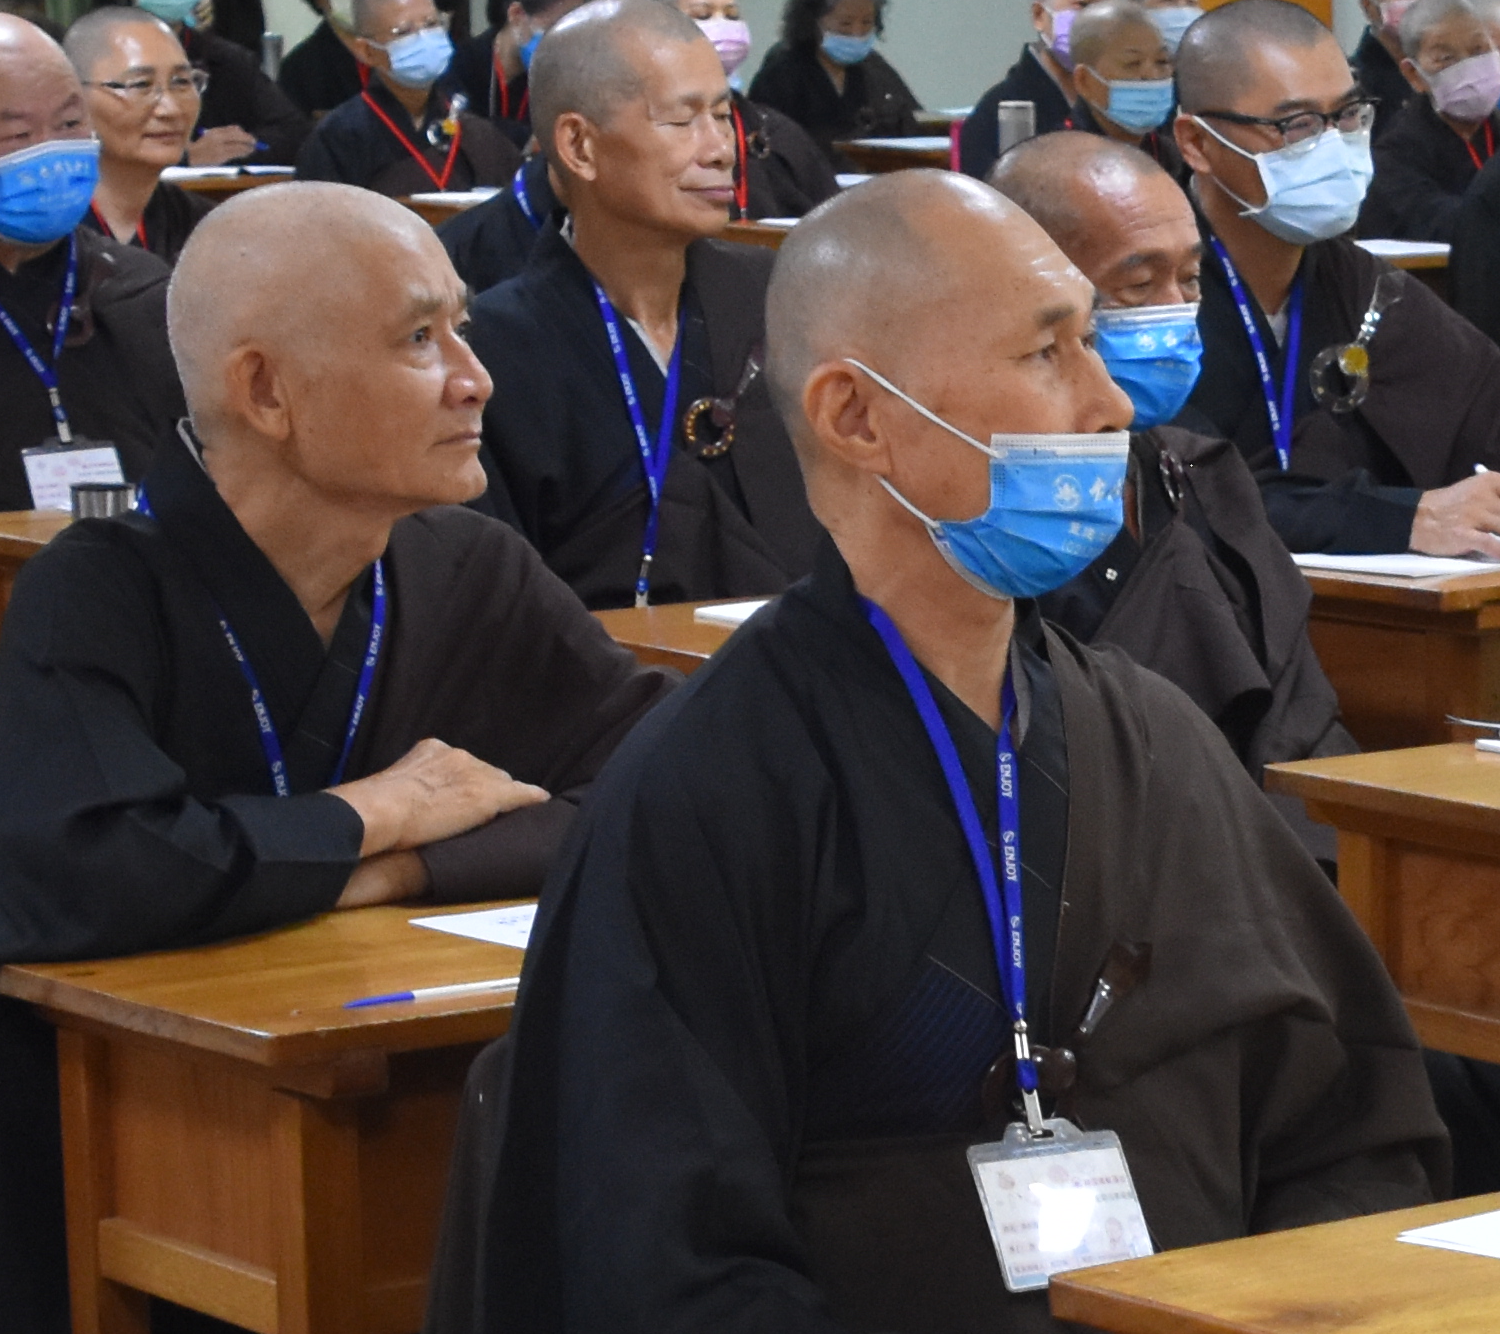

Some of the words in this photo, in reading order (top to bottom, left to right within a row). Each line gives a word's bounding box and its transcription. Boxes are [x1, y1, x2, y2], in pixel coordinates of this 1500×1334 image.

[369, 624, 383, 655] ENJOY
[253, 702, 273, 733] ENJOY
[1000, 763, 1014, 799] ENJOY
[1005, 845, 1017, 882] ENJOY
[1011, 930, 1022, 969] ENJOY
